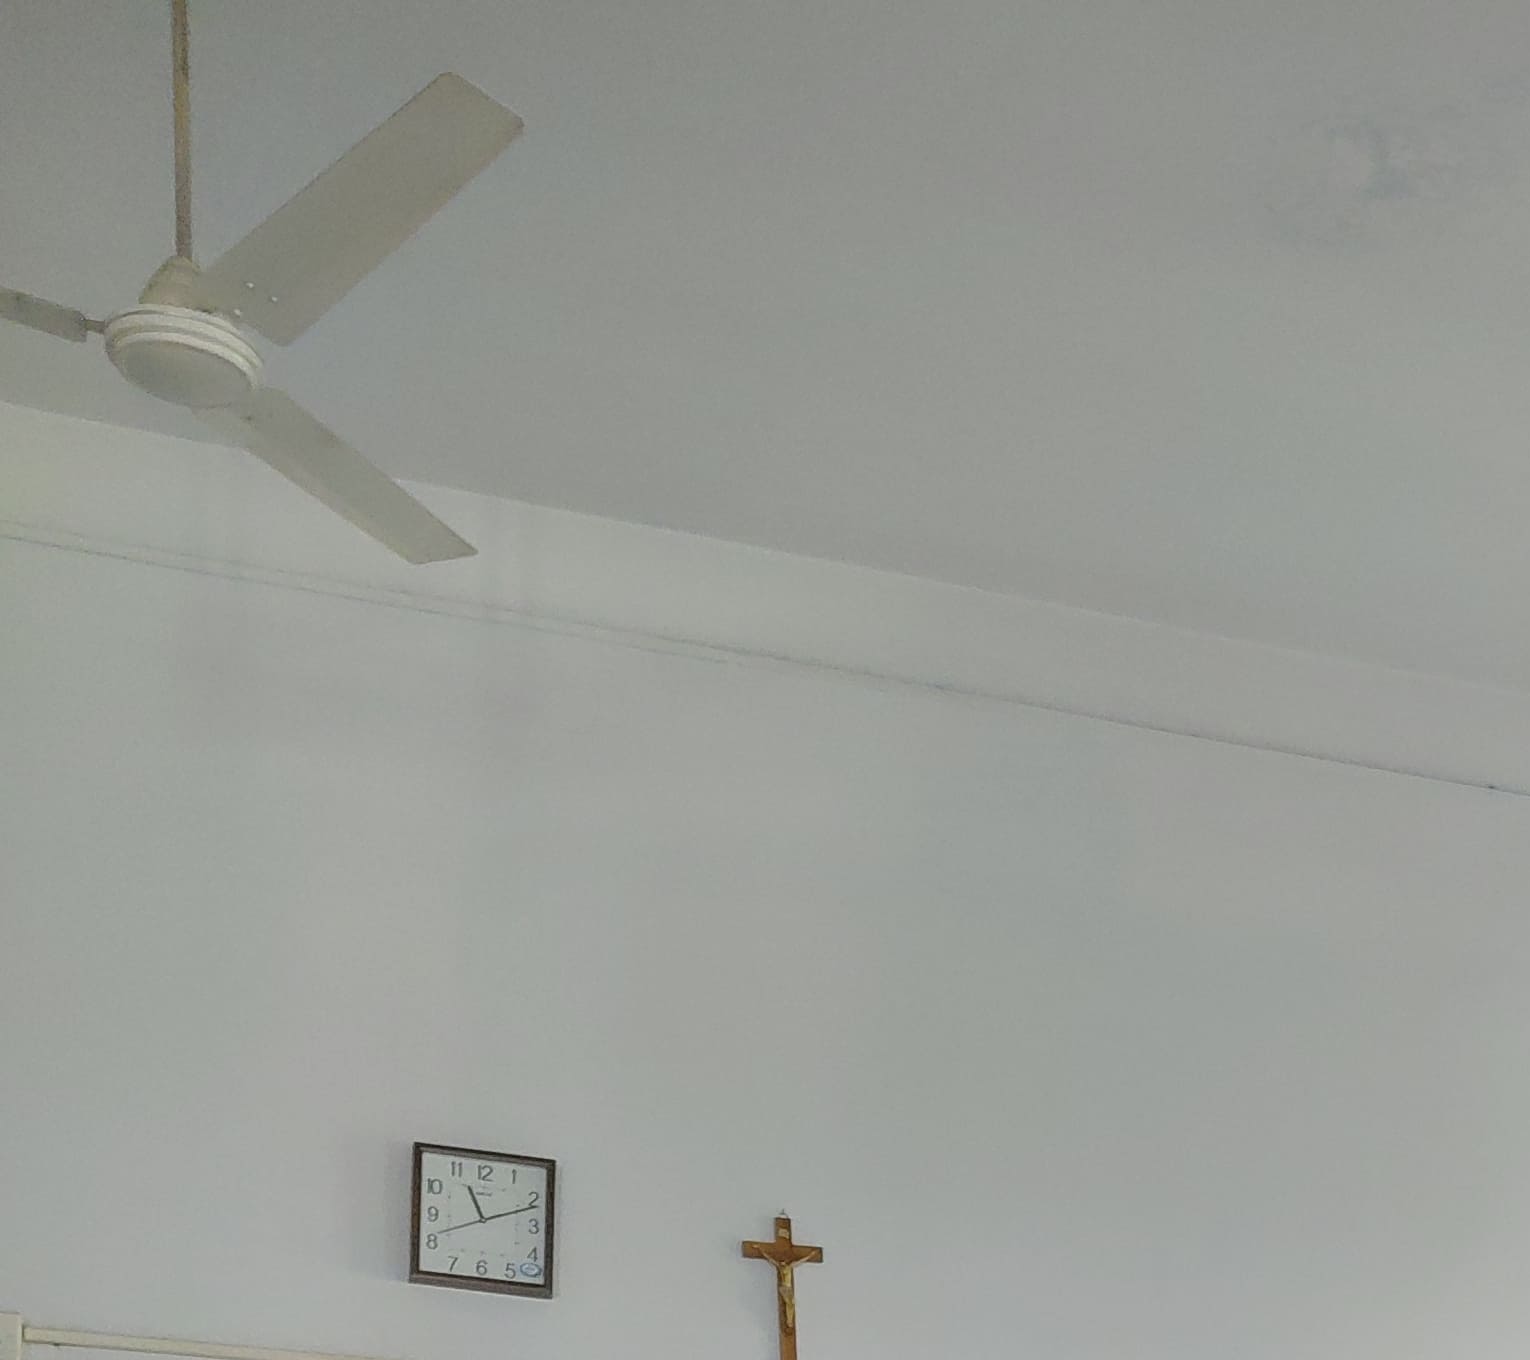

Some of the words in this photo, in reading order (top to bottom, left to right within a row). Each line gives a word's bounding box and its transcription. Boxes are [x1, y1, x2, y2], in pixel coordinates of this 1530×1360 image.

[451, 1160, 463, 1178] 11
[477, 1164, 494, 1182] 12
[511, 1168, 517, 1185] 1
[427, 1178, 443, 1195] 10
[527, 1191, 540, 1207] 2
[427, 1206, 439, 1222] 9
[528, 1218, 540, 1235] 3
[425, 1233, 439, 1250] 8
[526, 1246, 538, 1262] 4
[447, 1255, 459, 1273] 7
[475, 1259, 488, 1276] 6
[504, 1262, 517, 1279] 5
